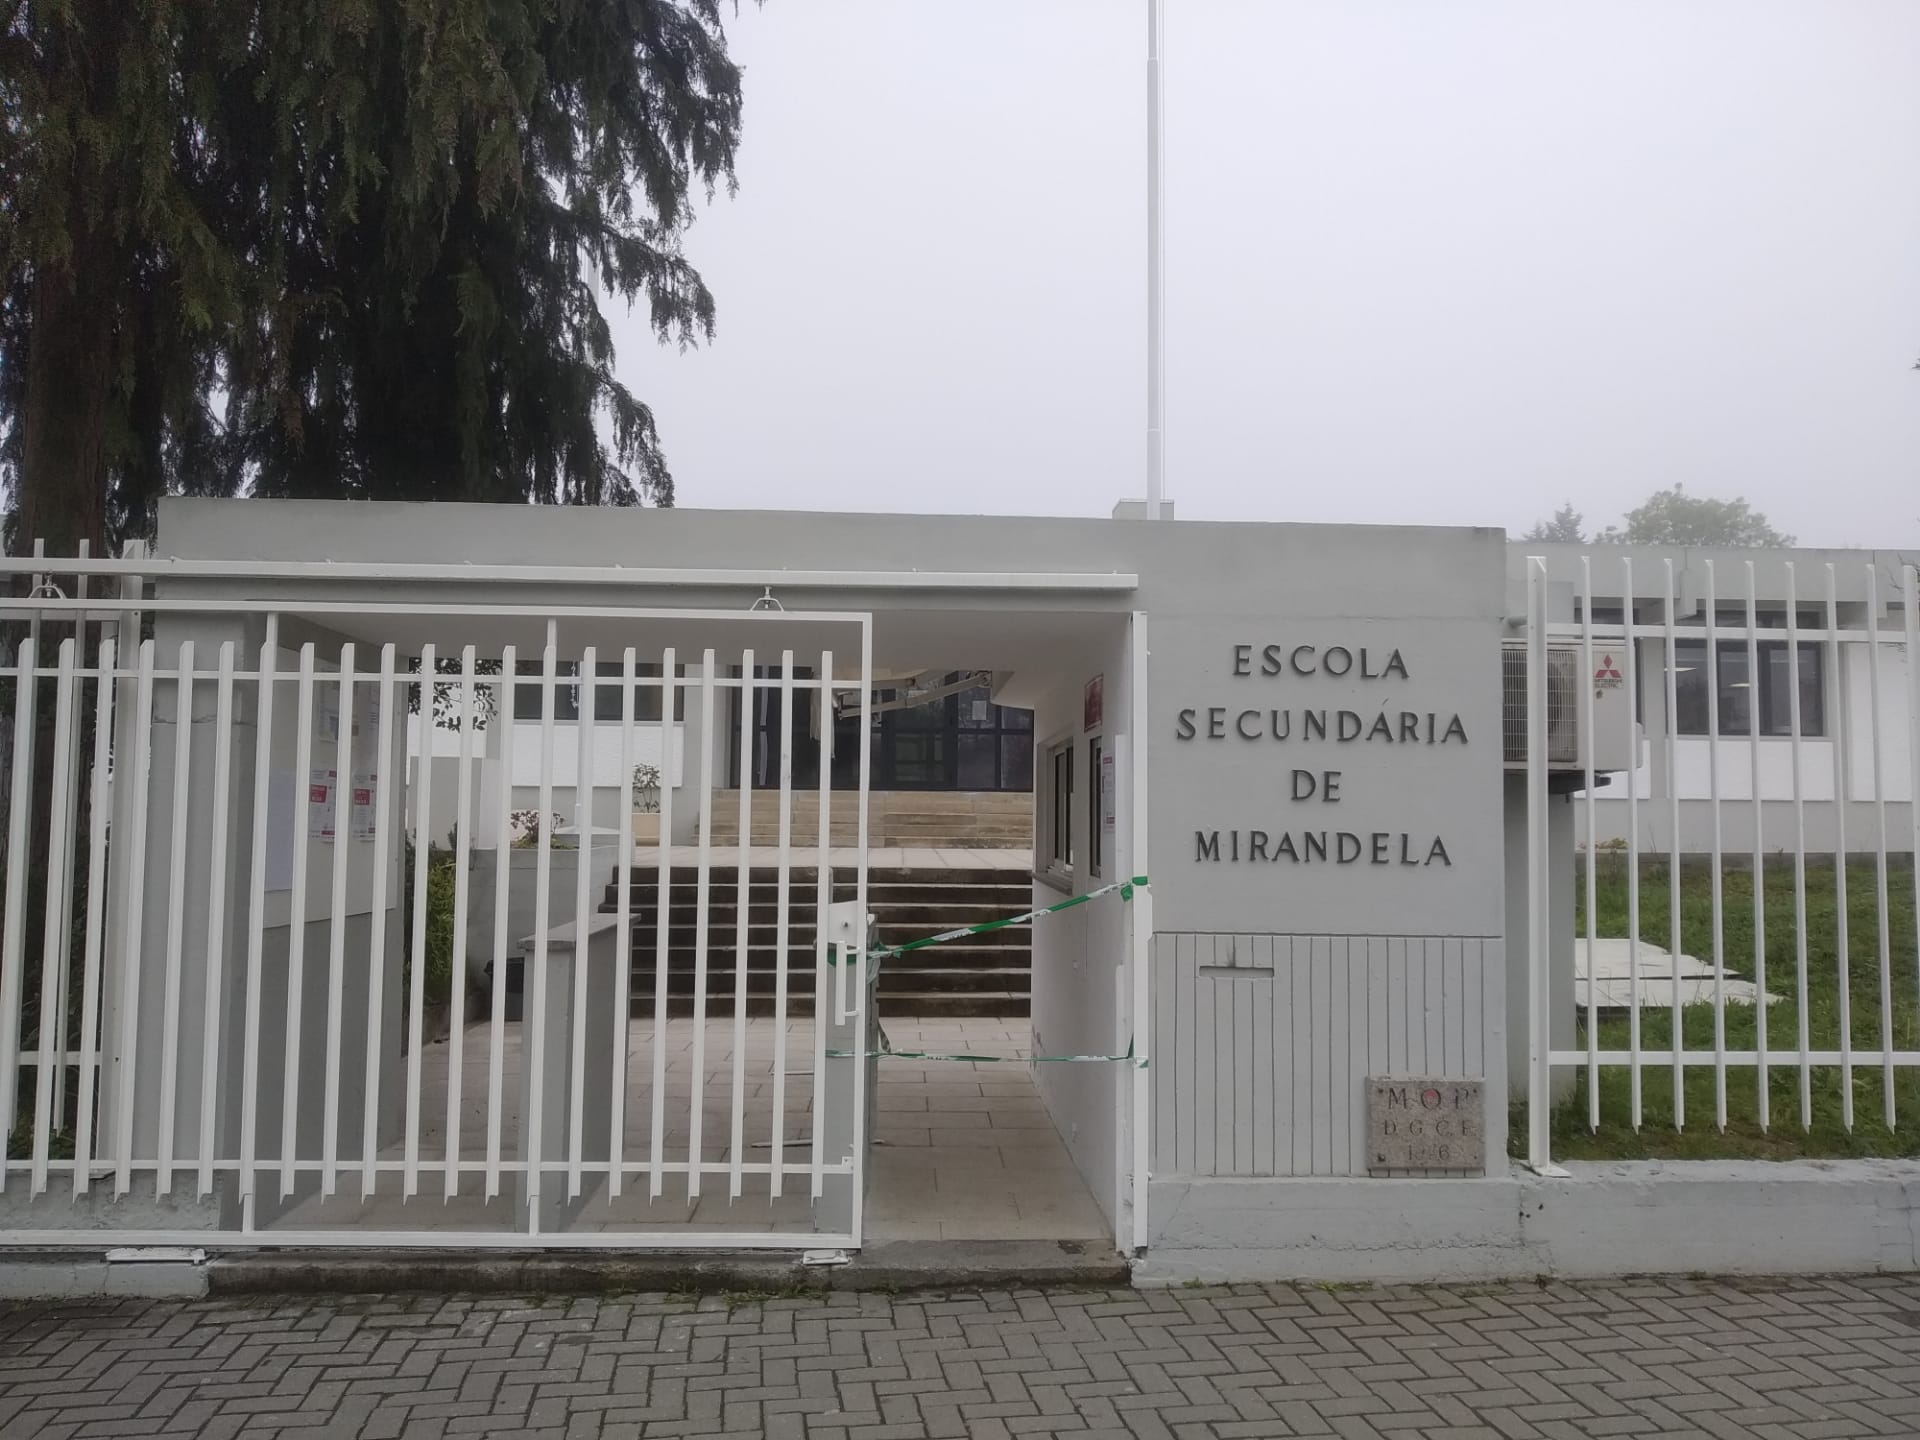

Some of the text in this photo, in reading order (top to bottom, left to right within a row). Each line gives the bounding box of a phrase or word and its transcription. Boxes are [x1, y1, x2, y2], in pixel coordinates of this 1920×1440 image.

[1233, 645, 1409, 679] ESCOLA
[1176, 698, 1468, 744] SECUNDÁRIA
[1291, 769, 1342, 802] DE
[1195, 830, 1452, 866] MIRANDELA
